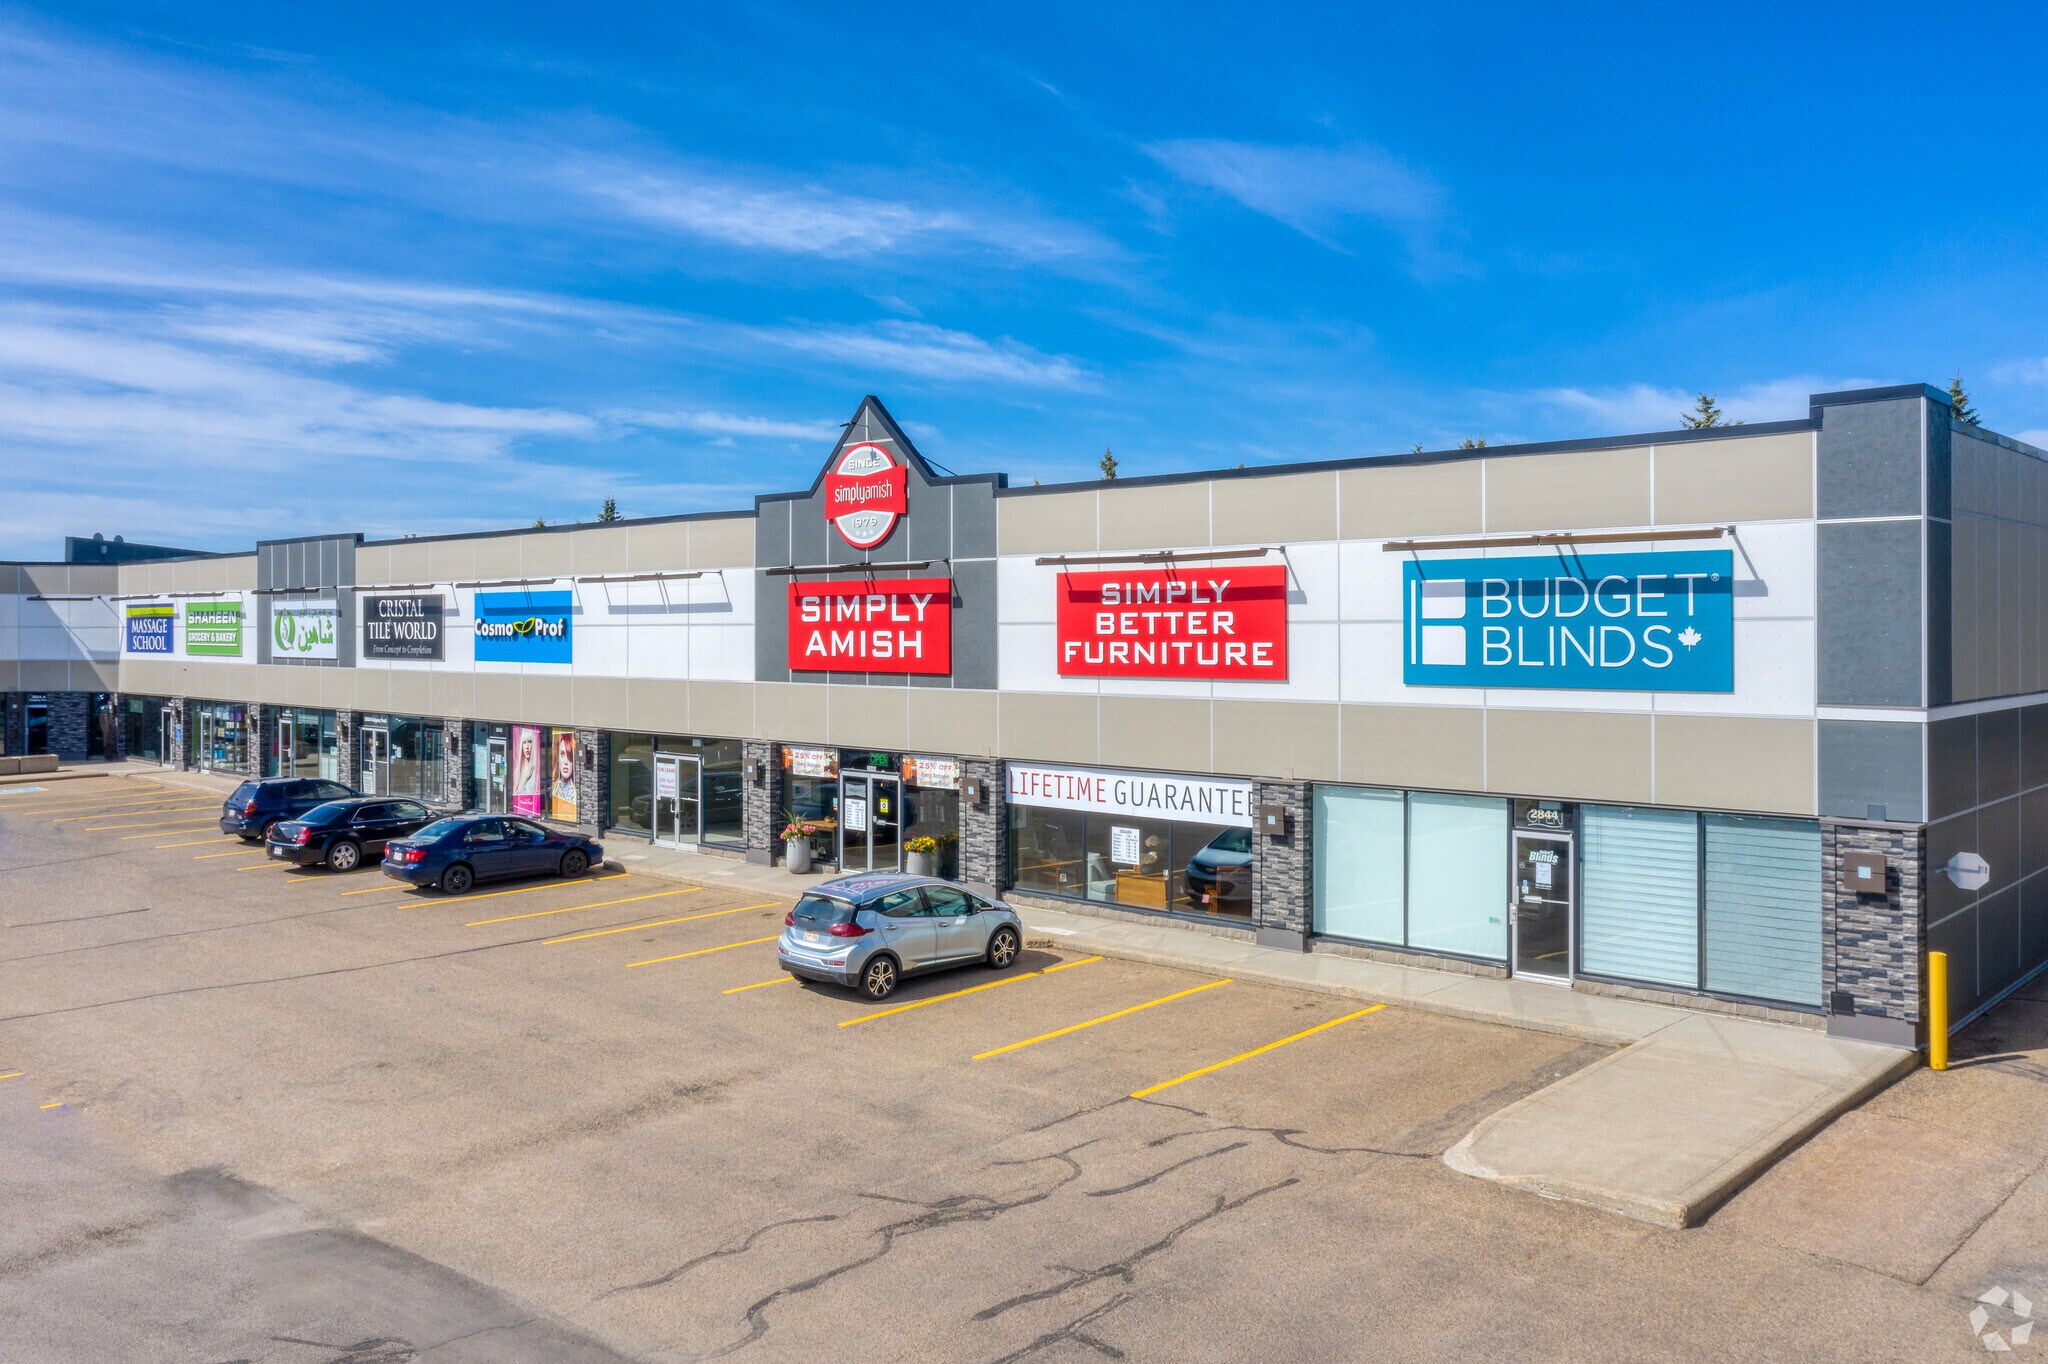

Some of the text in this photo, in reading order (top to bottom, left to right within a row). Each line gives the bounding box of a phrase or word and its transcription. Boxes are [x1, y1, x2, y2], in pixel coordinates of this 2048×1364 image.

[848, 457, 881, 470] SINCE
[834, 479, 893, 505] simplyamish
[851, 516, 877, 528] 1979
[1101, 579, 1231, 605] SIMPLY
[378, 598, 424, 618] CRISTAL
[801, 593, 933, 624] SIMPLY
[131, 618, 168, 634] MASSAGE
[188, 611, 237, 624] SHAHEEN
[1095, 610, 1236, 636] BETTER
[367, 621, 437, 640] TILE WORLD
[474, 618, 564, 637] Cosmo Prof
[132, 636, 167, 651] SCHOOL
[188, 632, 210, 642] GROCERY
[216, 632, 237, 643] BAKERY
[804, 629, 923, 659] AMISH
[1482, 624, 1674, 668] BLINDS
[407, 644, 432, 657] Completion
[1064, 640, 1274, 667] FURNITURE
[870, 753, 888, 765] OPEN
[919, 762, 936, 770] 25%
[1009, 770, 1107, 804] LIFETIME
[1530, 808, 1559, 820] 2844
[1529, 851, 1558, 863] Blinds
